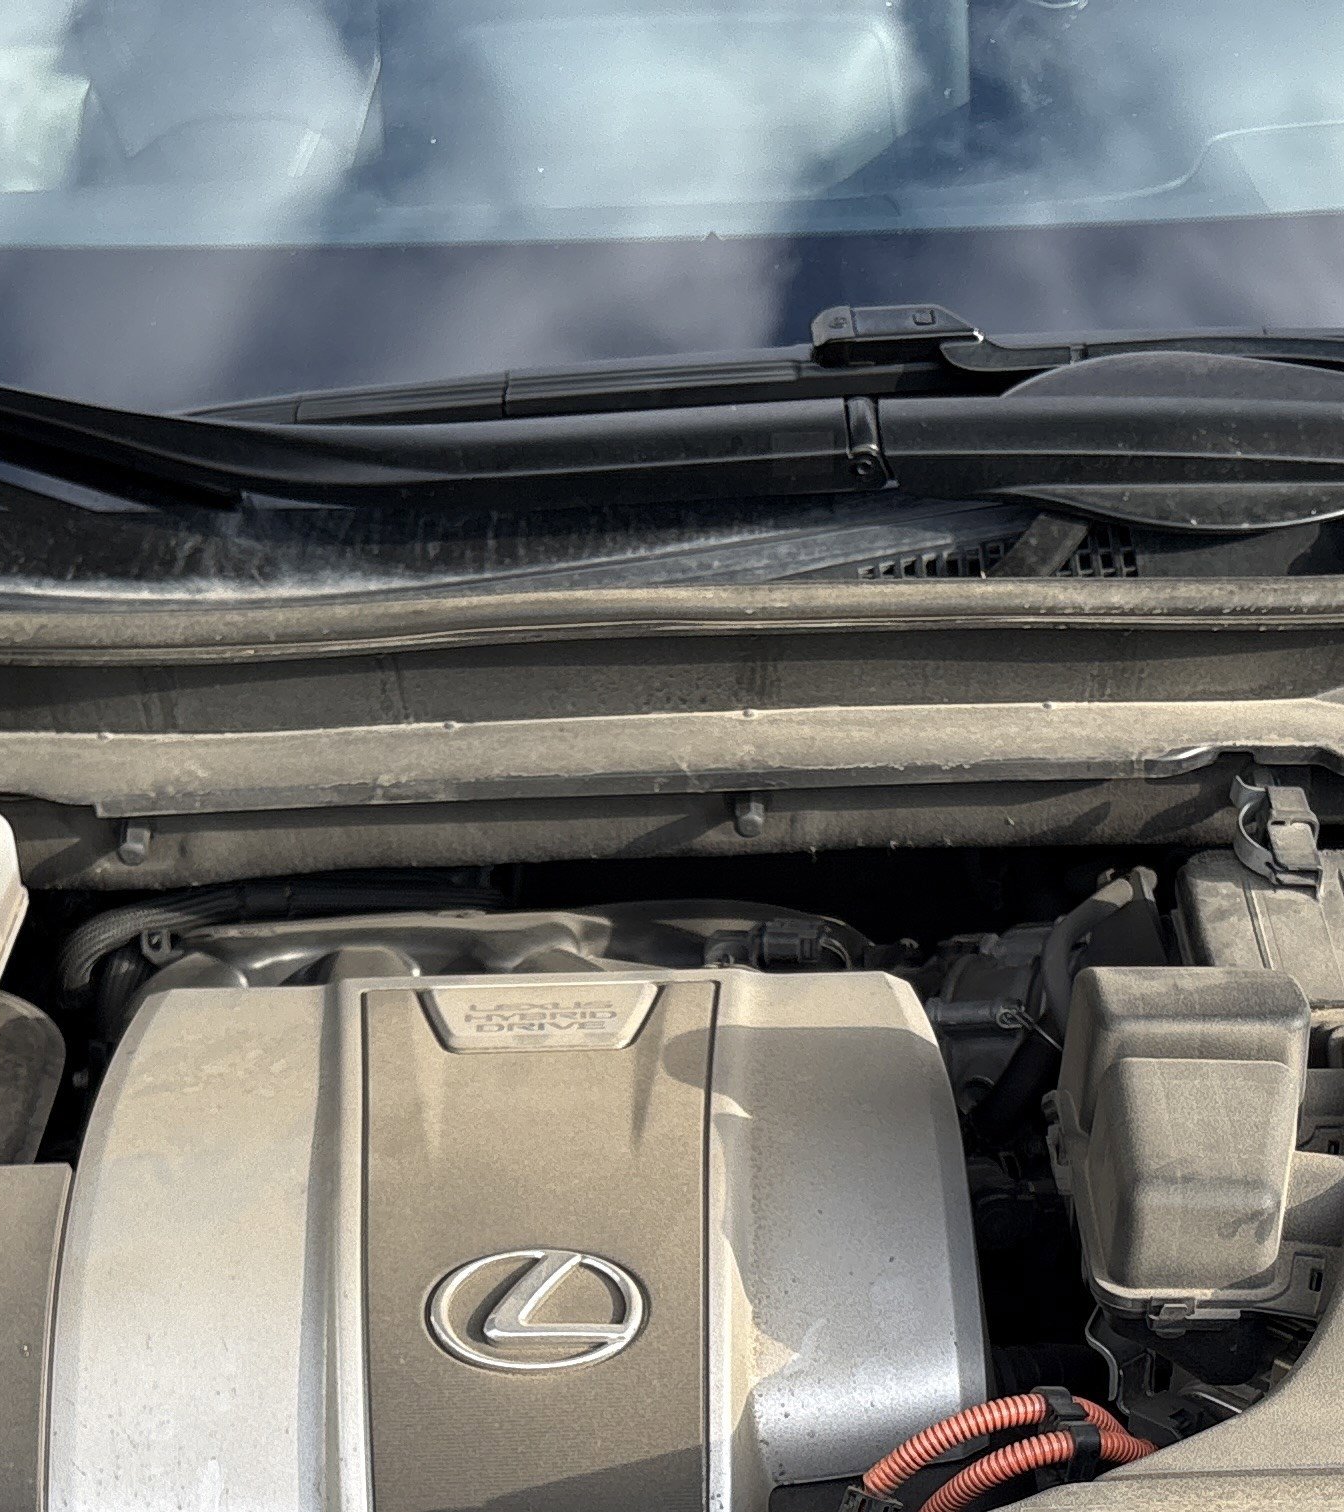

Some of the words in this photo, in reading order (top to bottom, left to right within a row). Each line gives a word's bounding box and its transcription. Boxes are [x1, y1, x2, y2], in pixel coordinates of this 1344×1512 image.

[469, 1001, 613, 1012] LEXUS
[464, 1010, 617, 1023] HYBRID
[476, 1021, 606, 1032] DRIVE
